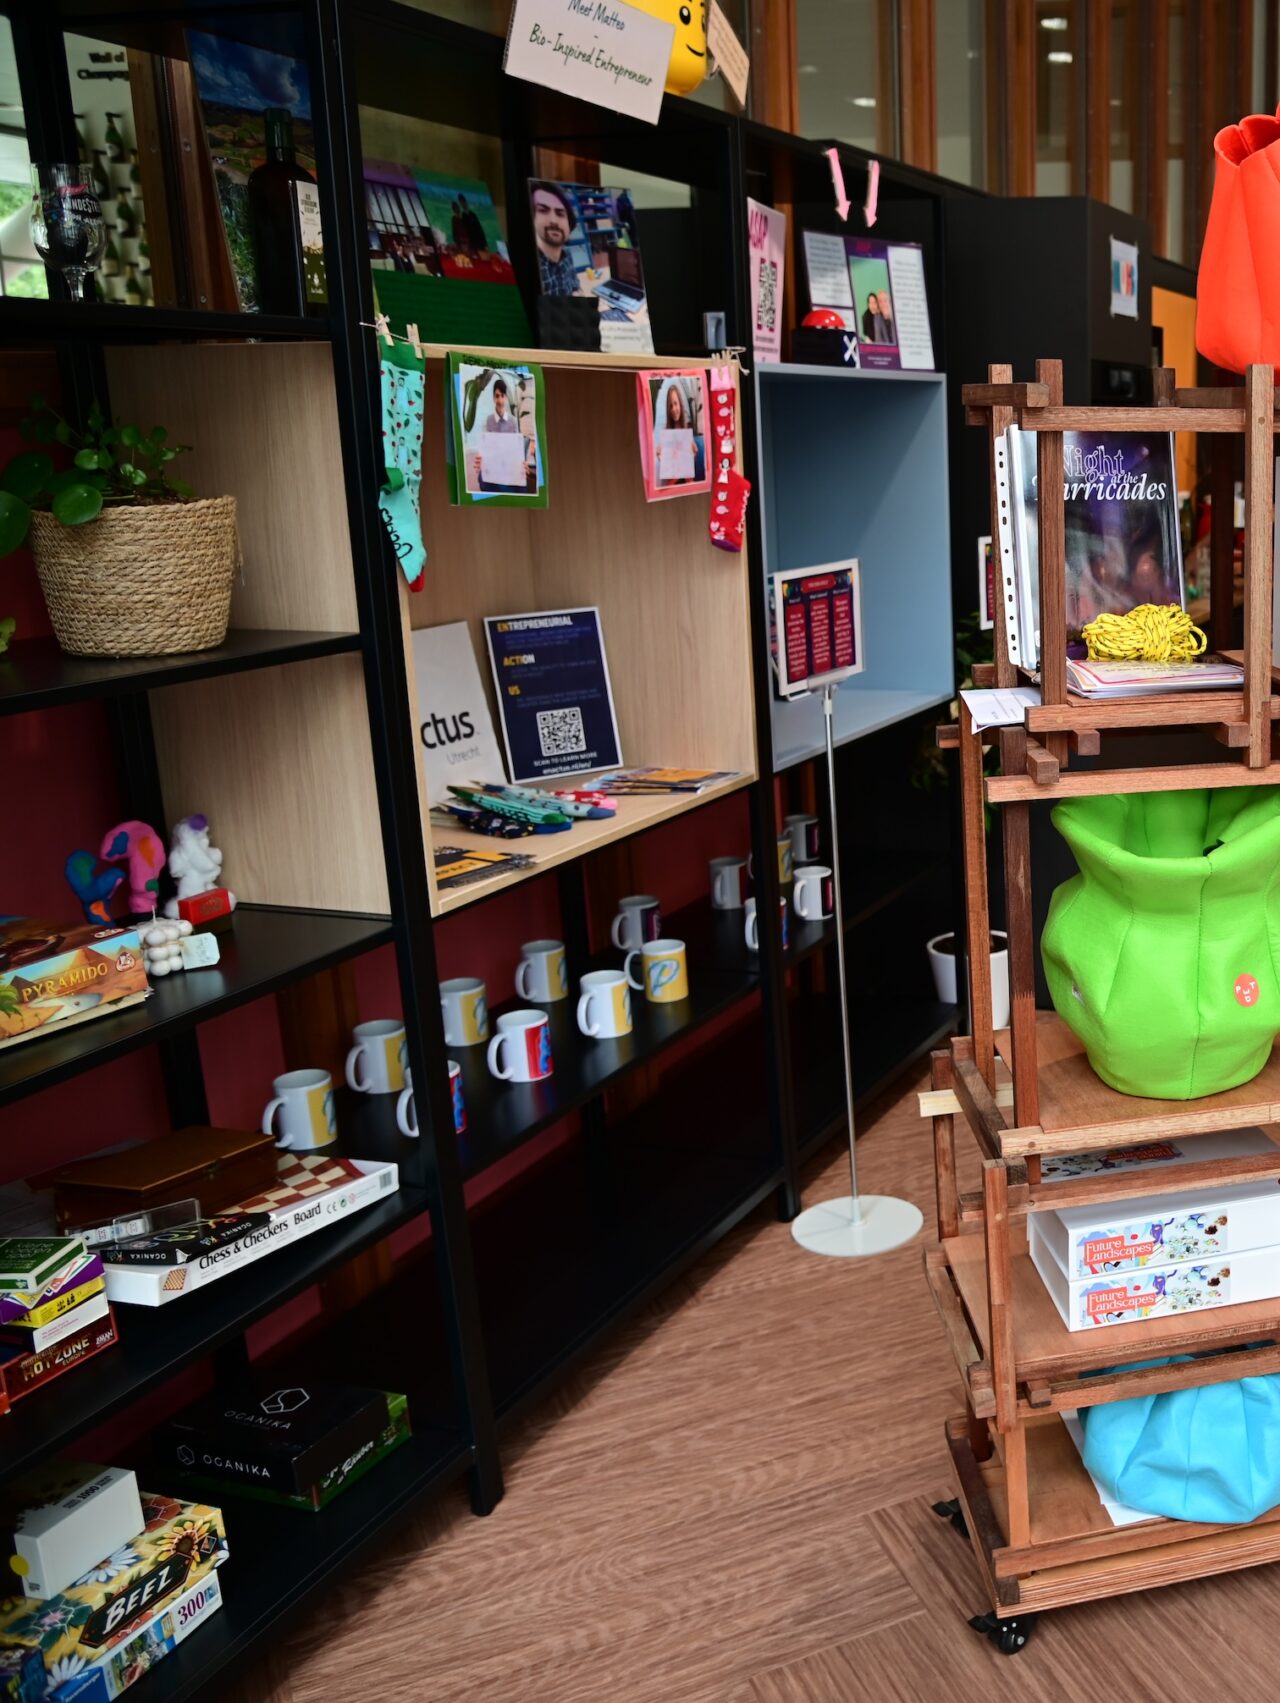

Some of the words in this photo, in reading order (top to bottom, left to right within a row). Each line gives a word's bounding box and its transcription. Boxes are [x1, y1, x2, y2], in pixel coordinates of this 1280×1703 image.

[567, 0, 593, 17] Meet
[595, 4, 626, 31] Matteo
[594, 49, 653, 87] Entrepreneur
[1123, 472, 1139, 484] the
[497, 615, 573, 632] ENTREPRENEURIAL
[503, 654, 535, 666] ACTION
[508, 686, 520, 695] US
[446, 746, 481, 766] Utrecht
[533, 759, 551, 767] SCAN
[552, 757, 560, 765] TO
[560, 755, 578, 763] LEARN
[579, 751, 598, 760] MORE
[22, 962, 108, 1002] PYRAMIDO
[199, 1248, 231, 1270] Chess
[233, 1241, 242, 1253] &
[243, 1220, 289, 1249] Checkers
[294, 1203, 322, 1225] Board
[1086, 1239, 1122, 1255] Future
[1086, 1244, 1152, 1263] Landscapes
[1088, 1290, 1125, 1306] Future
[1088, 1295, 1154, 1314] Landscapes
[203, 1454, 271, 1478] OGANIKA
[102, 1565, 172, 1635] BEEZ
[178, 1592, 205, 1625] 300
